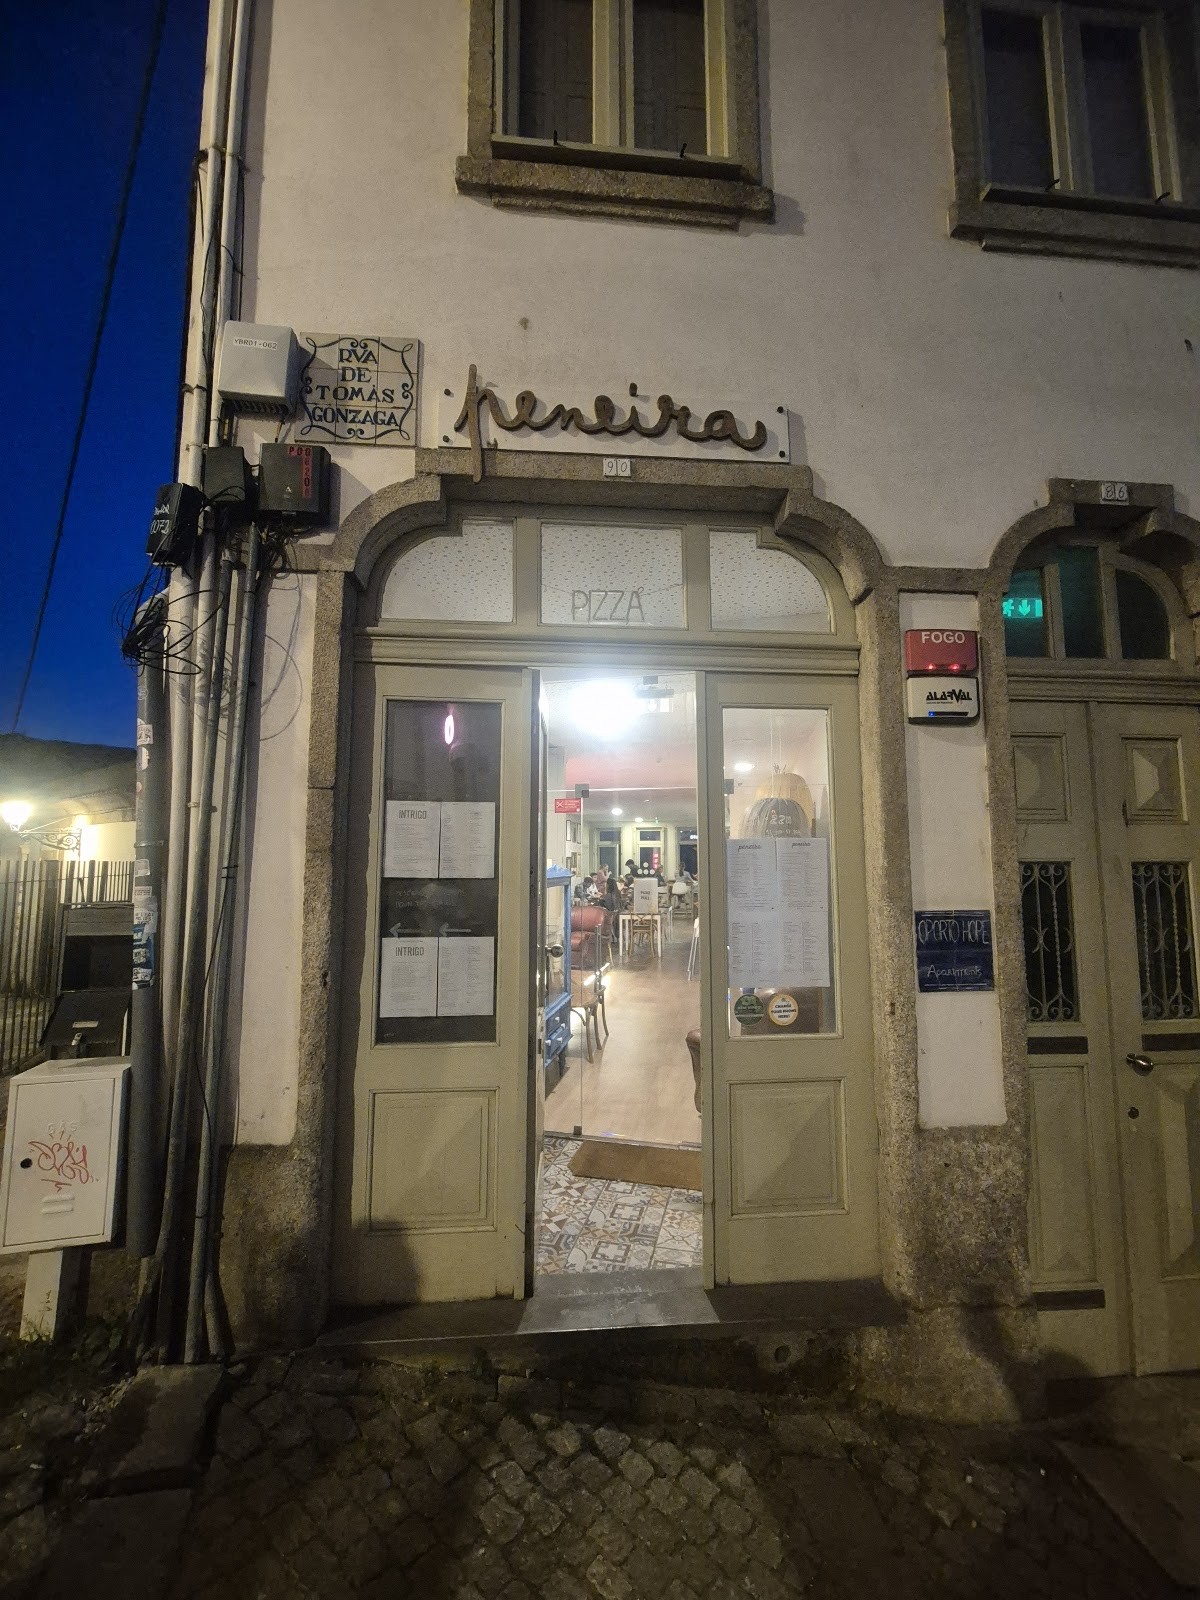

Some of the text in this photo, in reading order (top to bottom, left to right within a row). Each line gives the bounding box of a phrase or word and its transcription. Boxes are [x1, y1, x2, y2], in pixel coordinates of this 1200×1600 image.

[340, 366, 372, 383] DE
[311, 406, 399, 427] GONZAGA
[606, 460, 629, 474] 90
[1105, 485, 1125, 499] 86
[571, 588, 645, 626] PIZZA
[921, 631, 966, 644] FOGO
[398, 809, 427, 820] INTRIGO
[918, 919, 960, 945] OPORTO
[395, 946, 425, 957] INTRIGO
